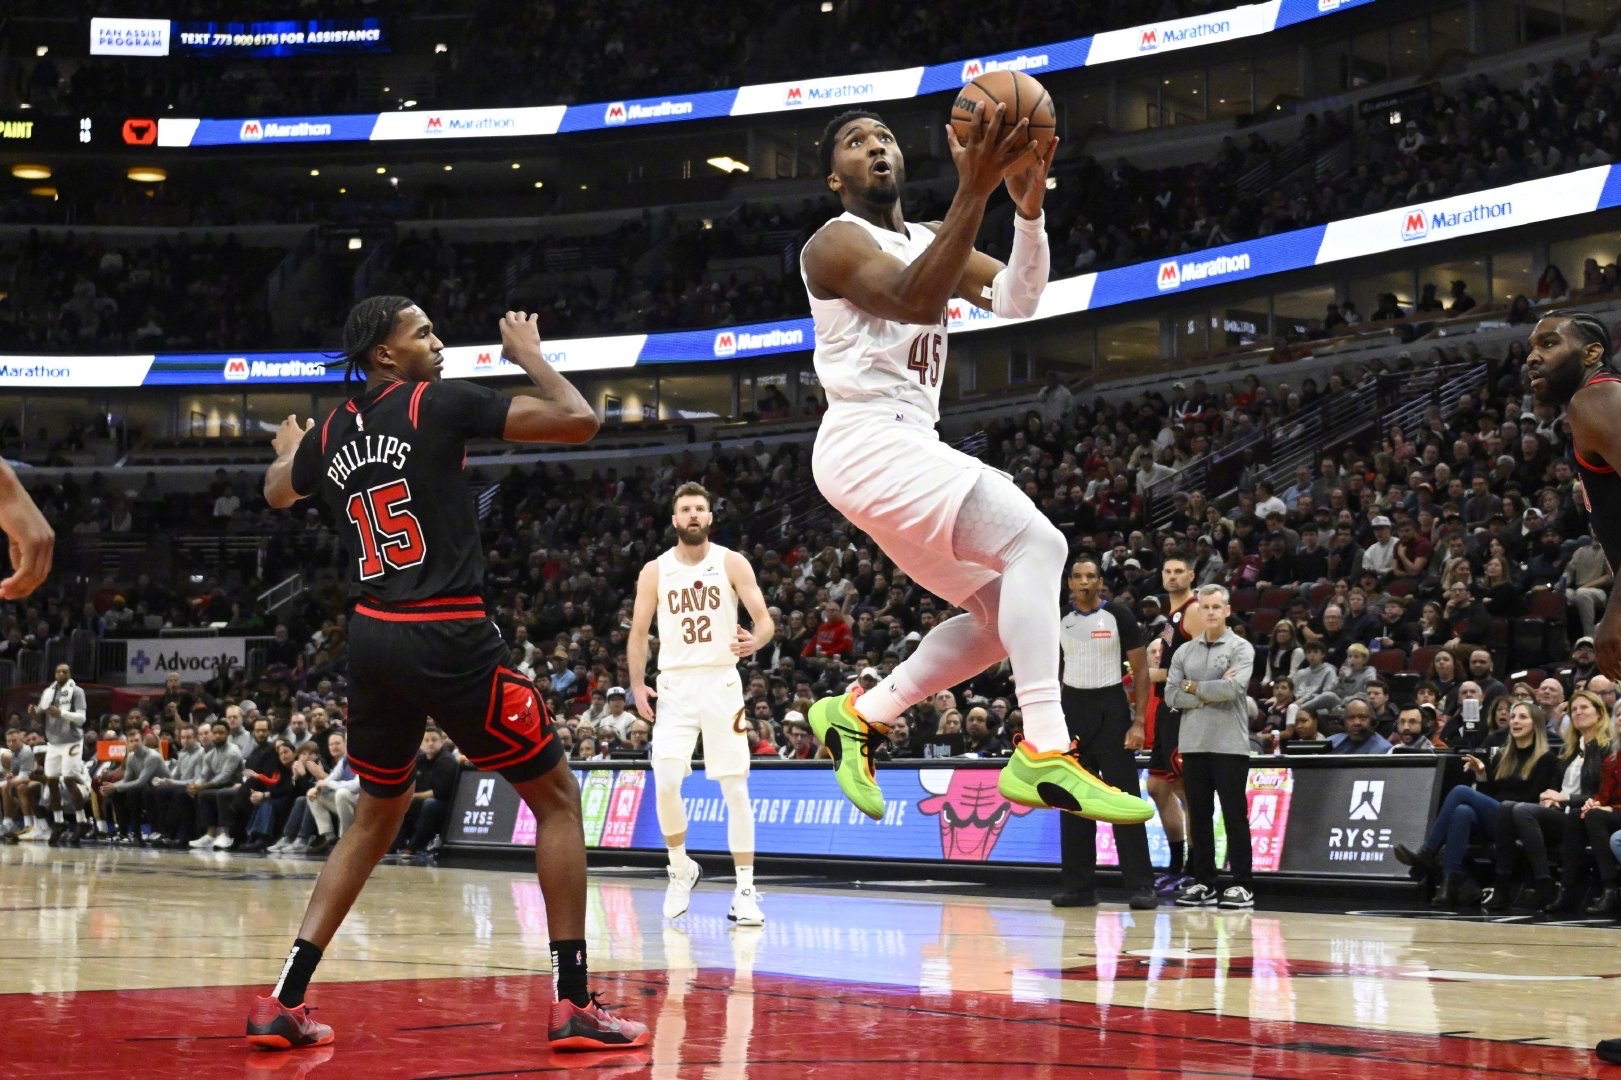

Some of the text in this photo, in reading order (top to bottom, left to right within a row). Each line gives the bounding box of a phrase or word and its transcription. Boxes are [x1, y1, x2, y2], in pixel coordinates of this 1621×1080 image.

[126, 29, 162, 37] ASSIST
[181, 33, 211, 44] TEXT
[280, 32, 305, 44] FOR
[307, 29, 381, 43] ASSISTANCE
[1162, 20, 1230, 43] Marathon
[99, 37, 162, 46] PROGRAM
[808, 82, 873, 101] Marathon
[628, 102, 692, 120] Marathon
[0, 121, 33, 138] PAINT
[265, 122, 331, 137] Marathon
[448, 116, 515, 130] Marathon
[1431, 202, 1512, 229] Marathon
[1181, 253, 1250, 282] Marathon
[737, 329, 803, 350] Marathon
[250, 360, 325, 377] Marathon
[907, 332, 942, 387] 45
[0, 364, 70, 378] Marathon
[327, 434, 412, 490] PHILLIPS
[346, 478, 427, 581] 15
[667, 584, 720, 615] CAVS
[681, 615, 712, 645] 32
[155, 651, 238, 671] Advocate
[463, 811, 494, 826] RYSE
[683, 798, 726, 822] FICIAL
[751, 799, 791, 823] ERGY
[794, 799, 844, 824] DRINK
[876, 800, 907, 826] HE
[516, 820, 537, 833] RYS
[607, 821, 633, 834] RYSE
[1251, 836, 1279, 854] YSE
[1329, 827, 1392, 848] RYSE
[1329, 850, 1384, 862] ENERGY DRINK
